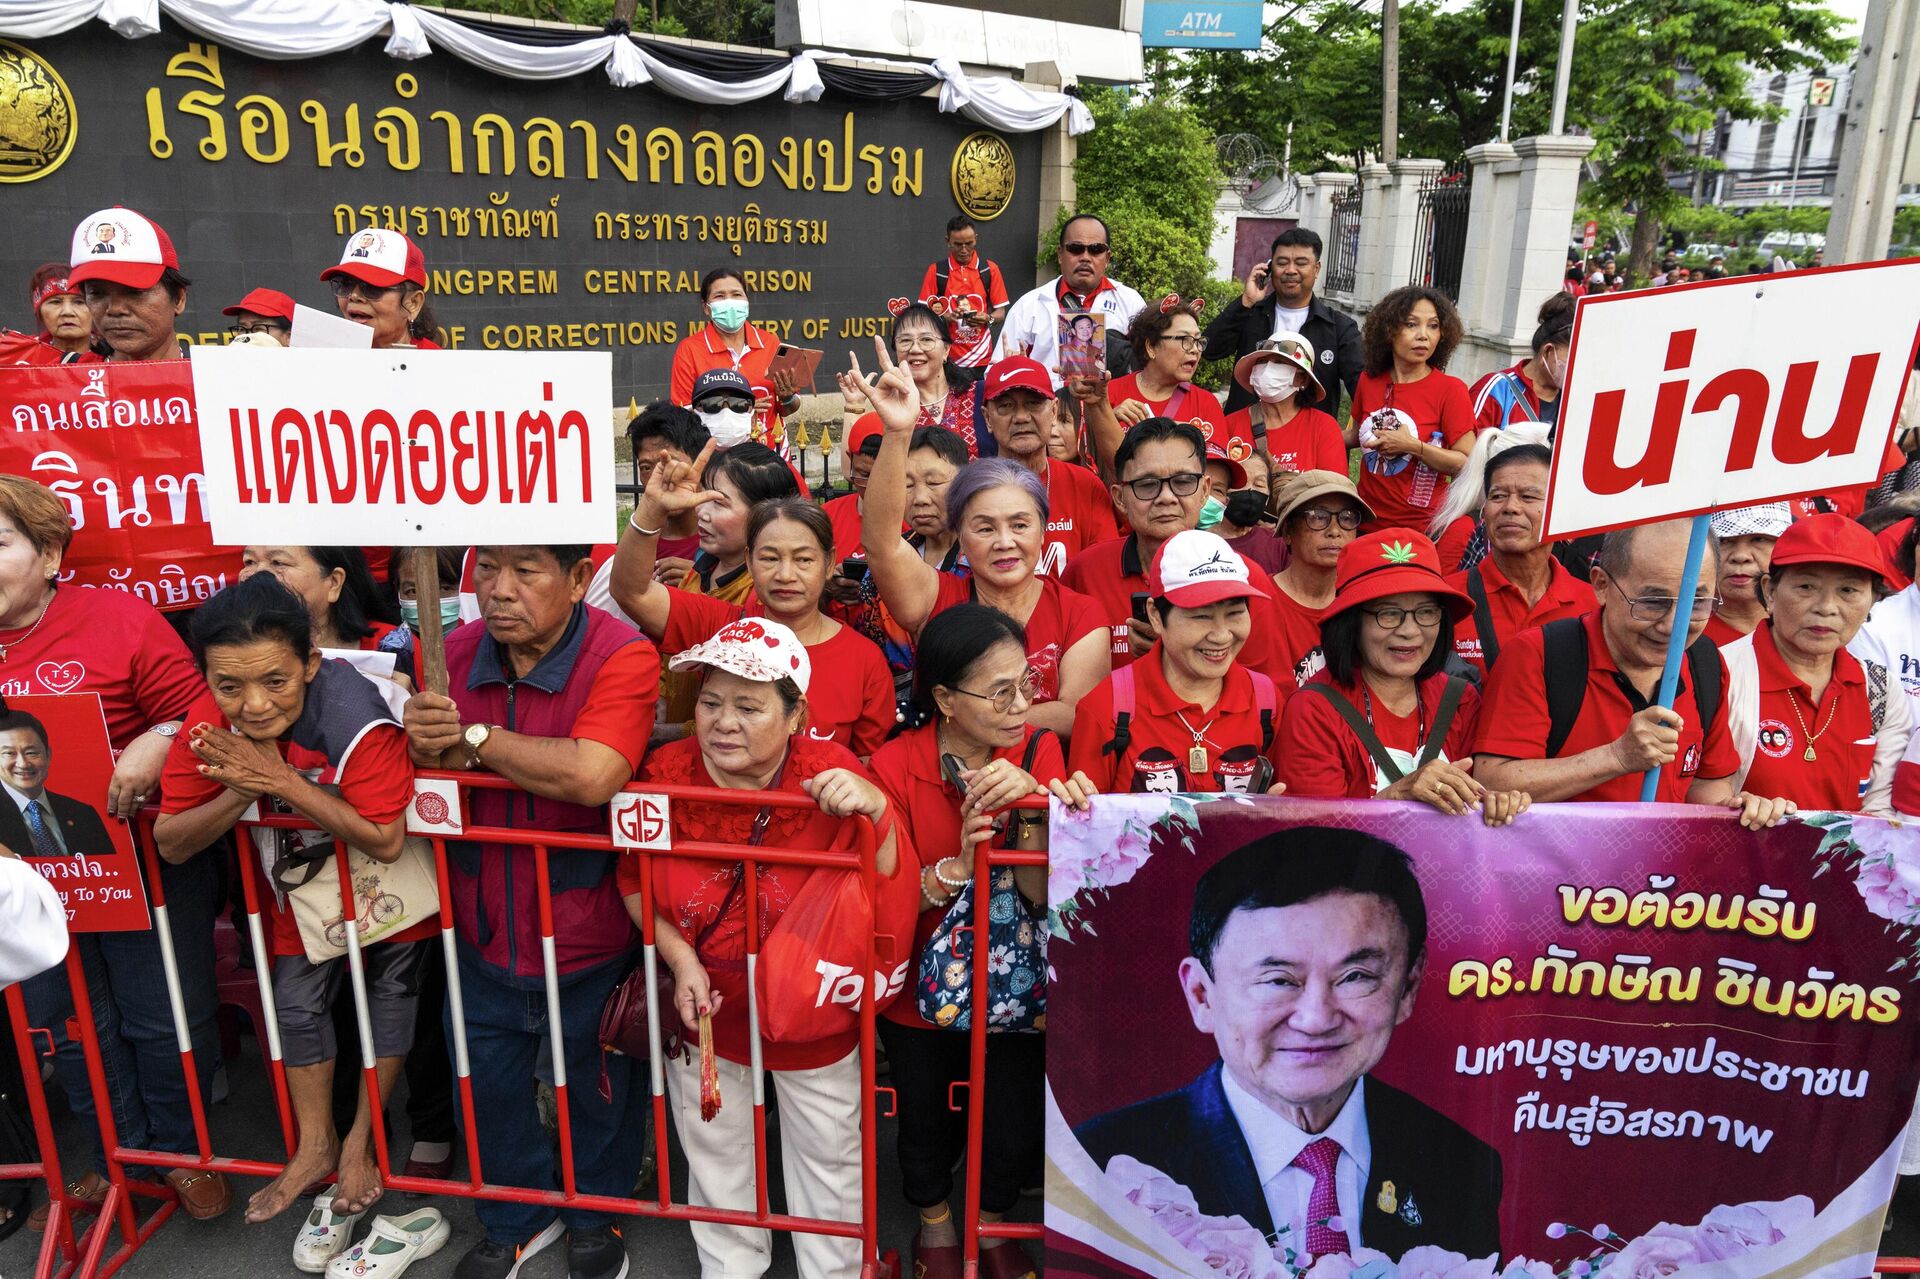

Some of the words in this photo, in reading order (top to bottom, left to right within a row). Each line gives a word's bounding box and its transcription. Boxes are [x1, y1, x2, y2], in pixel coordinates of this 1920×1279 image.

[1179, 12, 1223, 30] ATM
[146, 42, 923, 197] เรือนจำกลางคลองเปรม
[334, 191, 559, 239] กรมราชทัณฑ์
[594, 203, 828, 256] กระทรวงยุติธรรม
[422, 268, 559, 297] NGPREM
[585, 270, 702, 294] CENTRAL
[483, 321, 678, 348] CORRECTIONS
[803, 319, 829, 339] OF
[12, 369, 200, 433] คนเสื้อแด
[1582, 329, 1881, 496] น่าน
[229, 381, 592, 505] แดงดอยเต่า
[1046, 517, 1073, 531] อล์ฟ
[74, 887, 94, 901] To
[100, 887, 132, 903] You
[1558, 875, 1816, 940] ขอต้อนรับ
[1449, 944, 1701, 1001] ดร.ทักษิณ
[1715, 958, 1901, 1023] ชินวัตร
[1455, 1037, 1869, 1098] มหาบุรุษของประชาชน
[1514, 1091, 1773, 1154] คืนสู่อิสรภาพ
